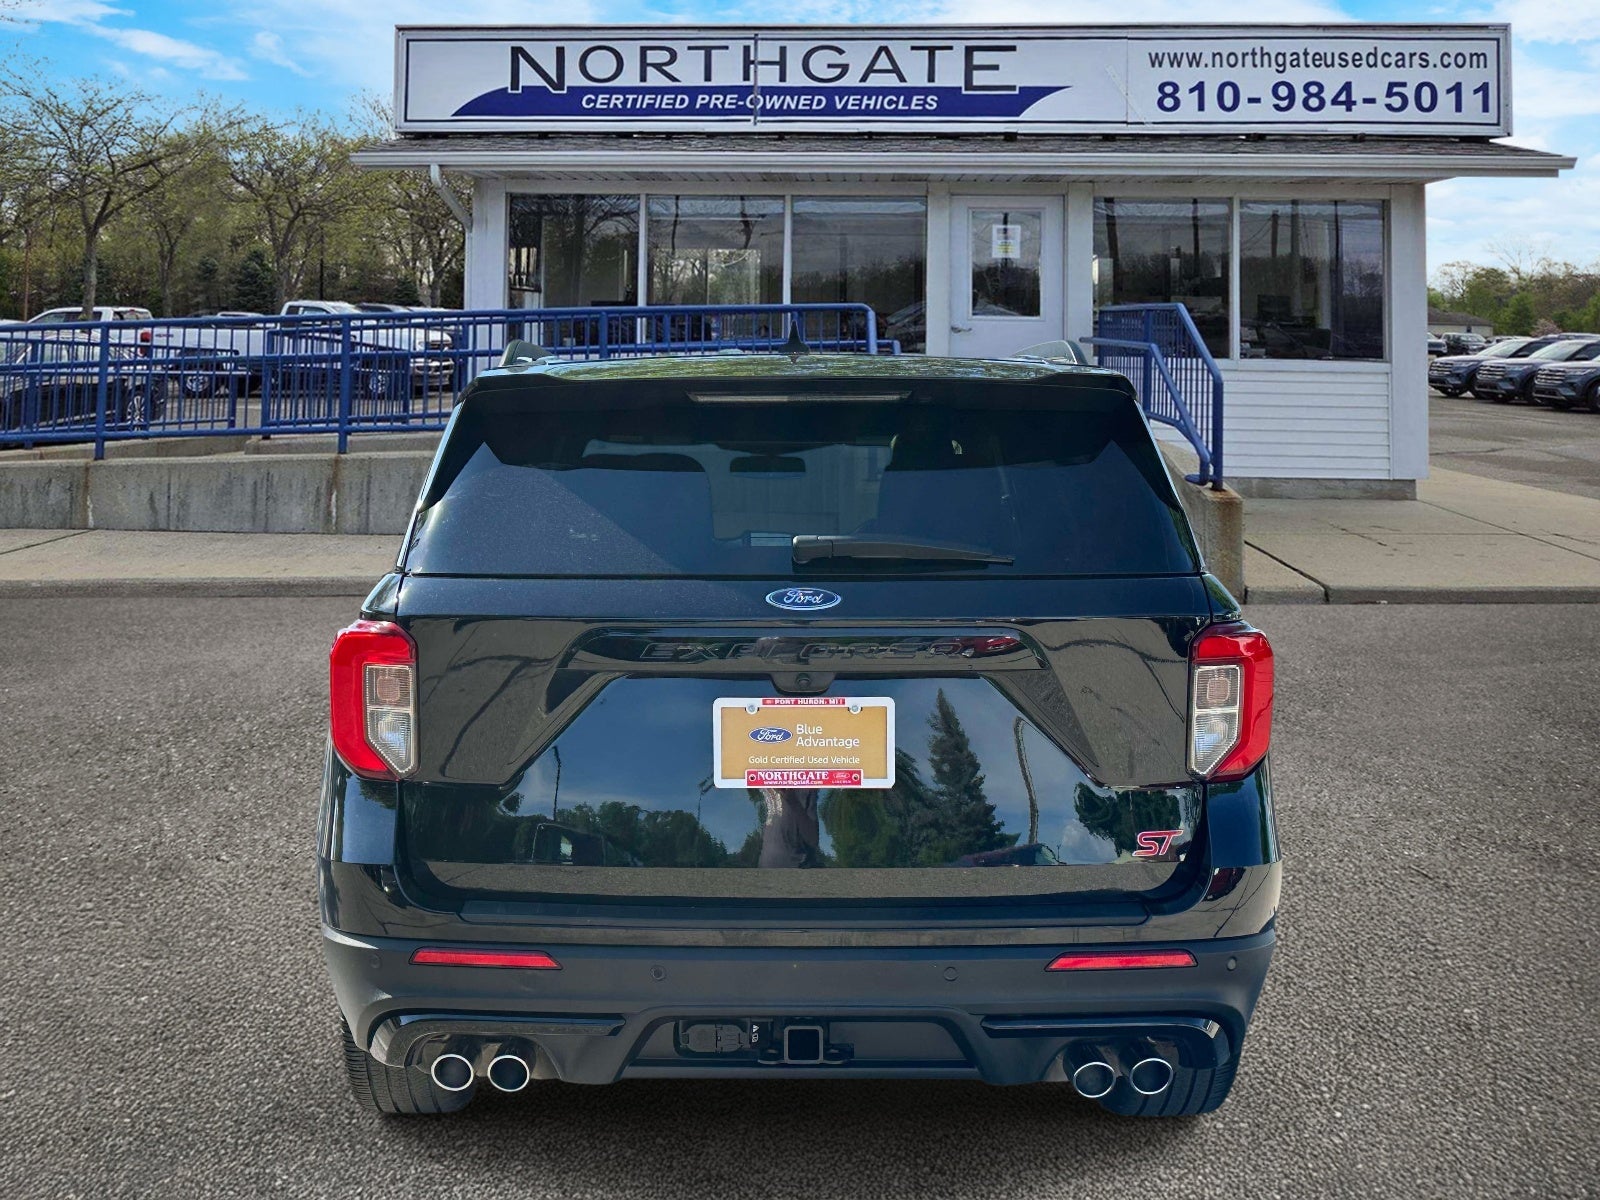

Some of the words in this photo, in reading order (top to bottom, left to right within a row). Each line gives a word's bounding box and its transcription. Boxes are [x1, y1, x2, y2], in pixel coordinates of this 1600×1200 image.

[1149, 46, 1488, 73] www.northgateusedcars.com
[510, 44, 1017, 92] NORTHGATE
[581, 94, 689, 110] CERTIFIED
[695, 94, 827, 110] PRE-OWNED
[834, 94, 938, 110] VEHICLES
[1156, 80, 1491, 114] 810-984-5011
[796, 723, 823, 735] Blue
[796, 736, 860, 749] Advantage
[748, 755, 768, 764] Gold
[770, 755, 805, 764] Certified
[807, 755, 829, 764] Used
[831, 755, 860, 764] Vehicle
[757, 771, 829, 781] NORTHGATE
[1132, 829, 1184, 857] ST
